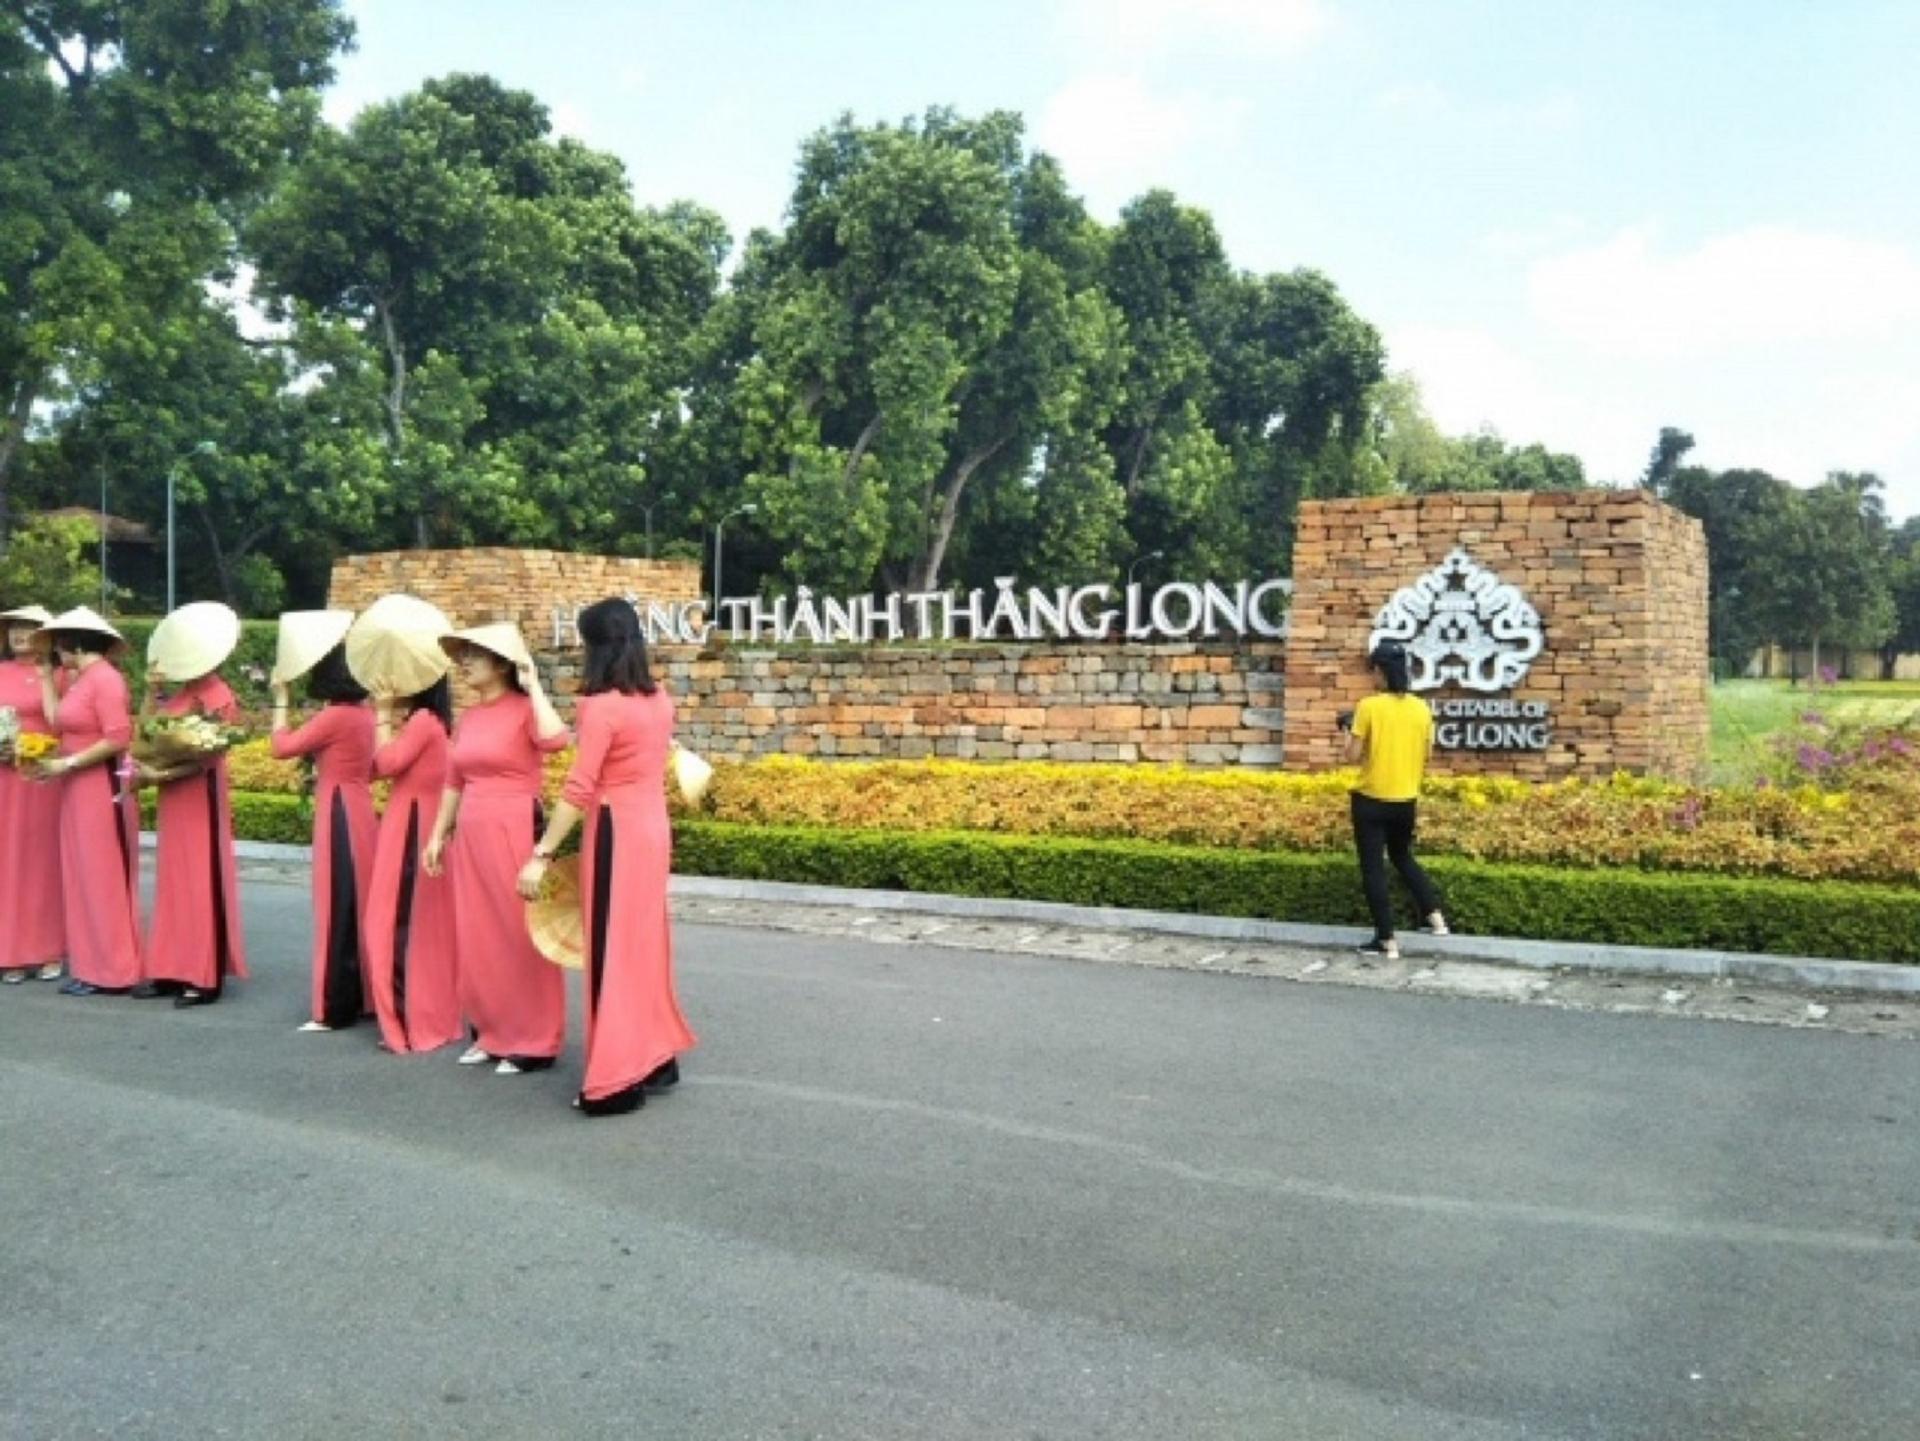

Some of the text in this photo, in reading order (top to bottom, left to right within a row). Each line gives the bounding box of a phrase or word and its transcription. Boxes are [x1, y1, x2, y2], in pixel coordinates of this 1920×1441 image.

[719, 585, 904, 643] THÀNH
[907, 576, 1119, 640] THĂNG
[1126, 578, 1292, 638] LONG
[1444, 699, 1520, 717] CITADEL
[1522, 701, 1547, 718] OF
[1465, 723, 1550, 749] LONG
